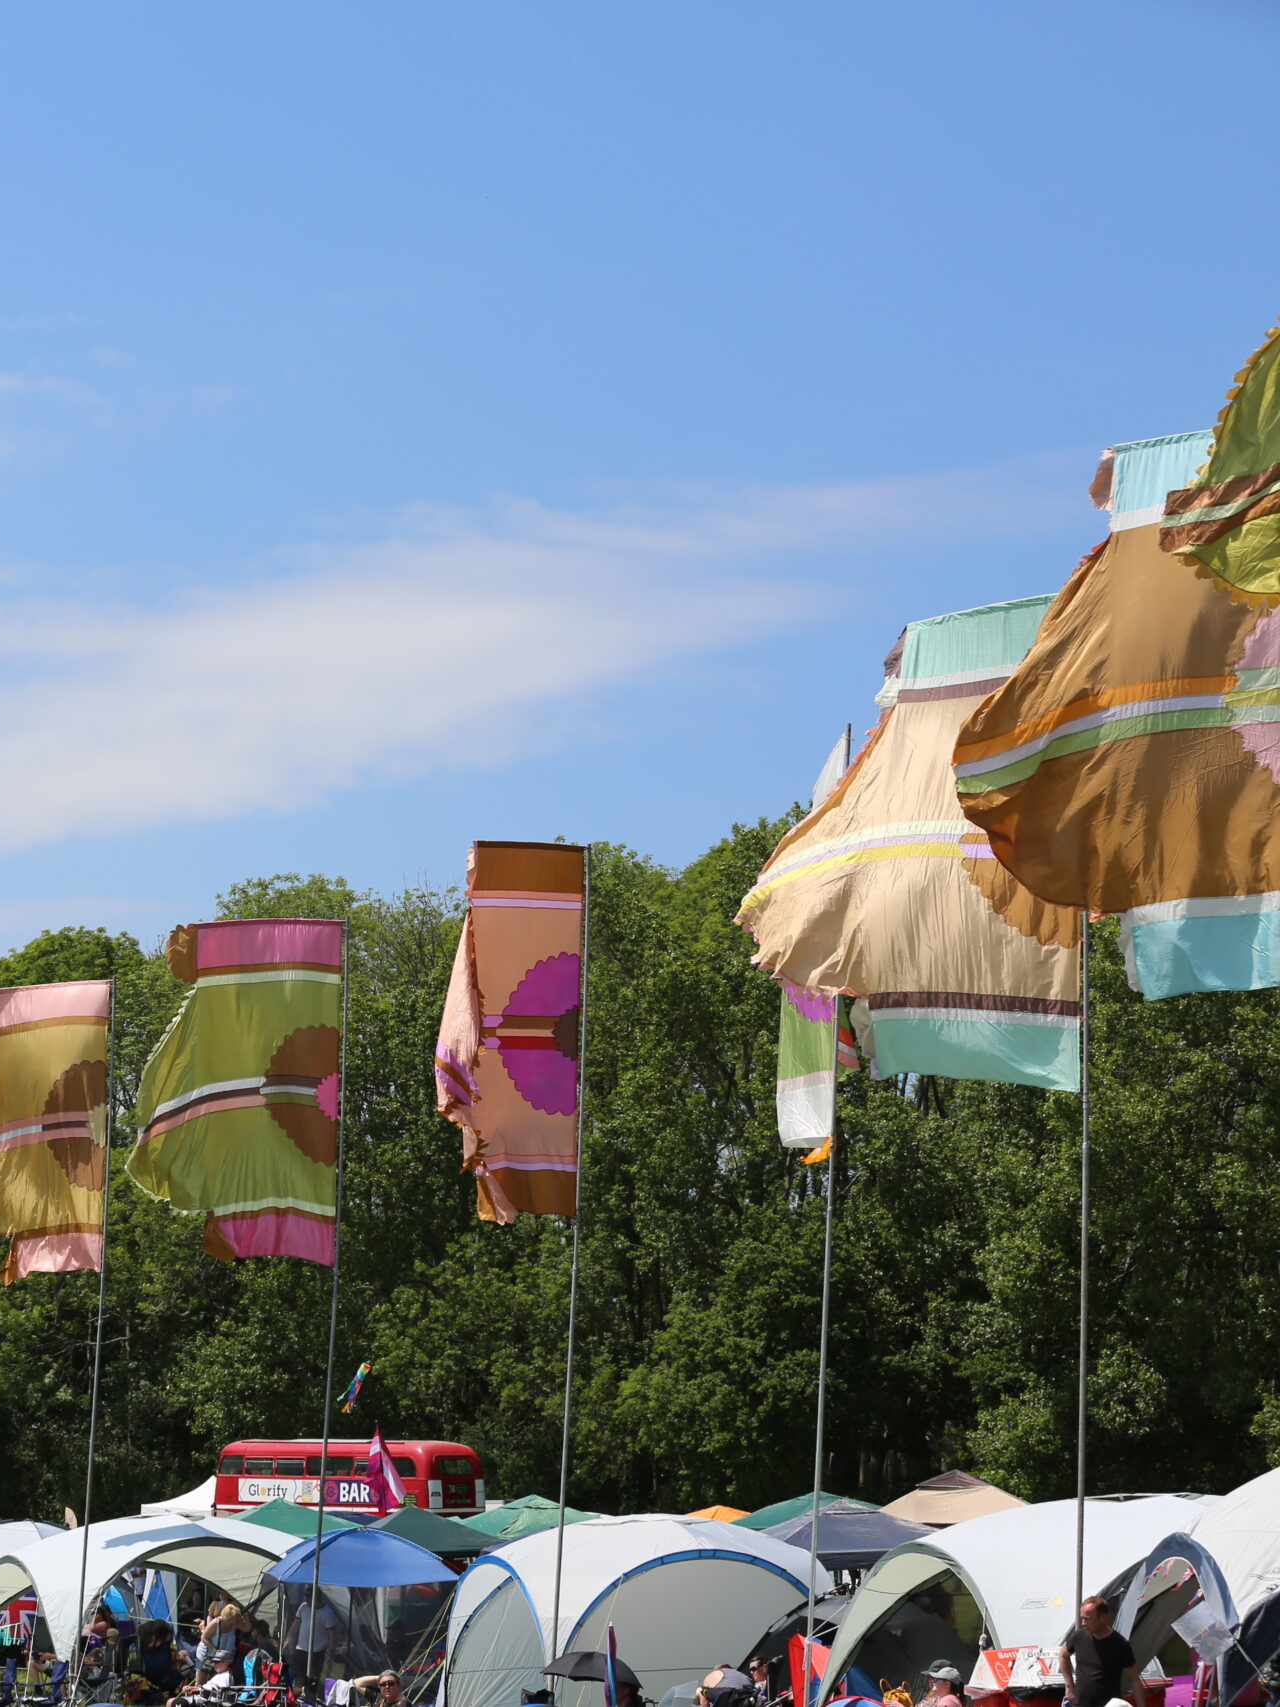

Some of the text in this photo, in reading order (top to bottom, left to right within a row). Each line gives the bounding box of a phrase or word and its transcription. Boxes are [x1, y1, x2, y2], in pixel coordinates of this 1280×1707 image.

[248, 1483, 288, 1498] Glorify
[339, 1482, 370, 1503] BAR
[997, 1651, 1018, 1659] Bottl
